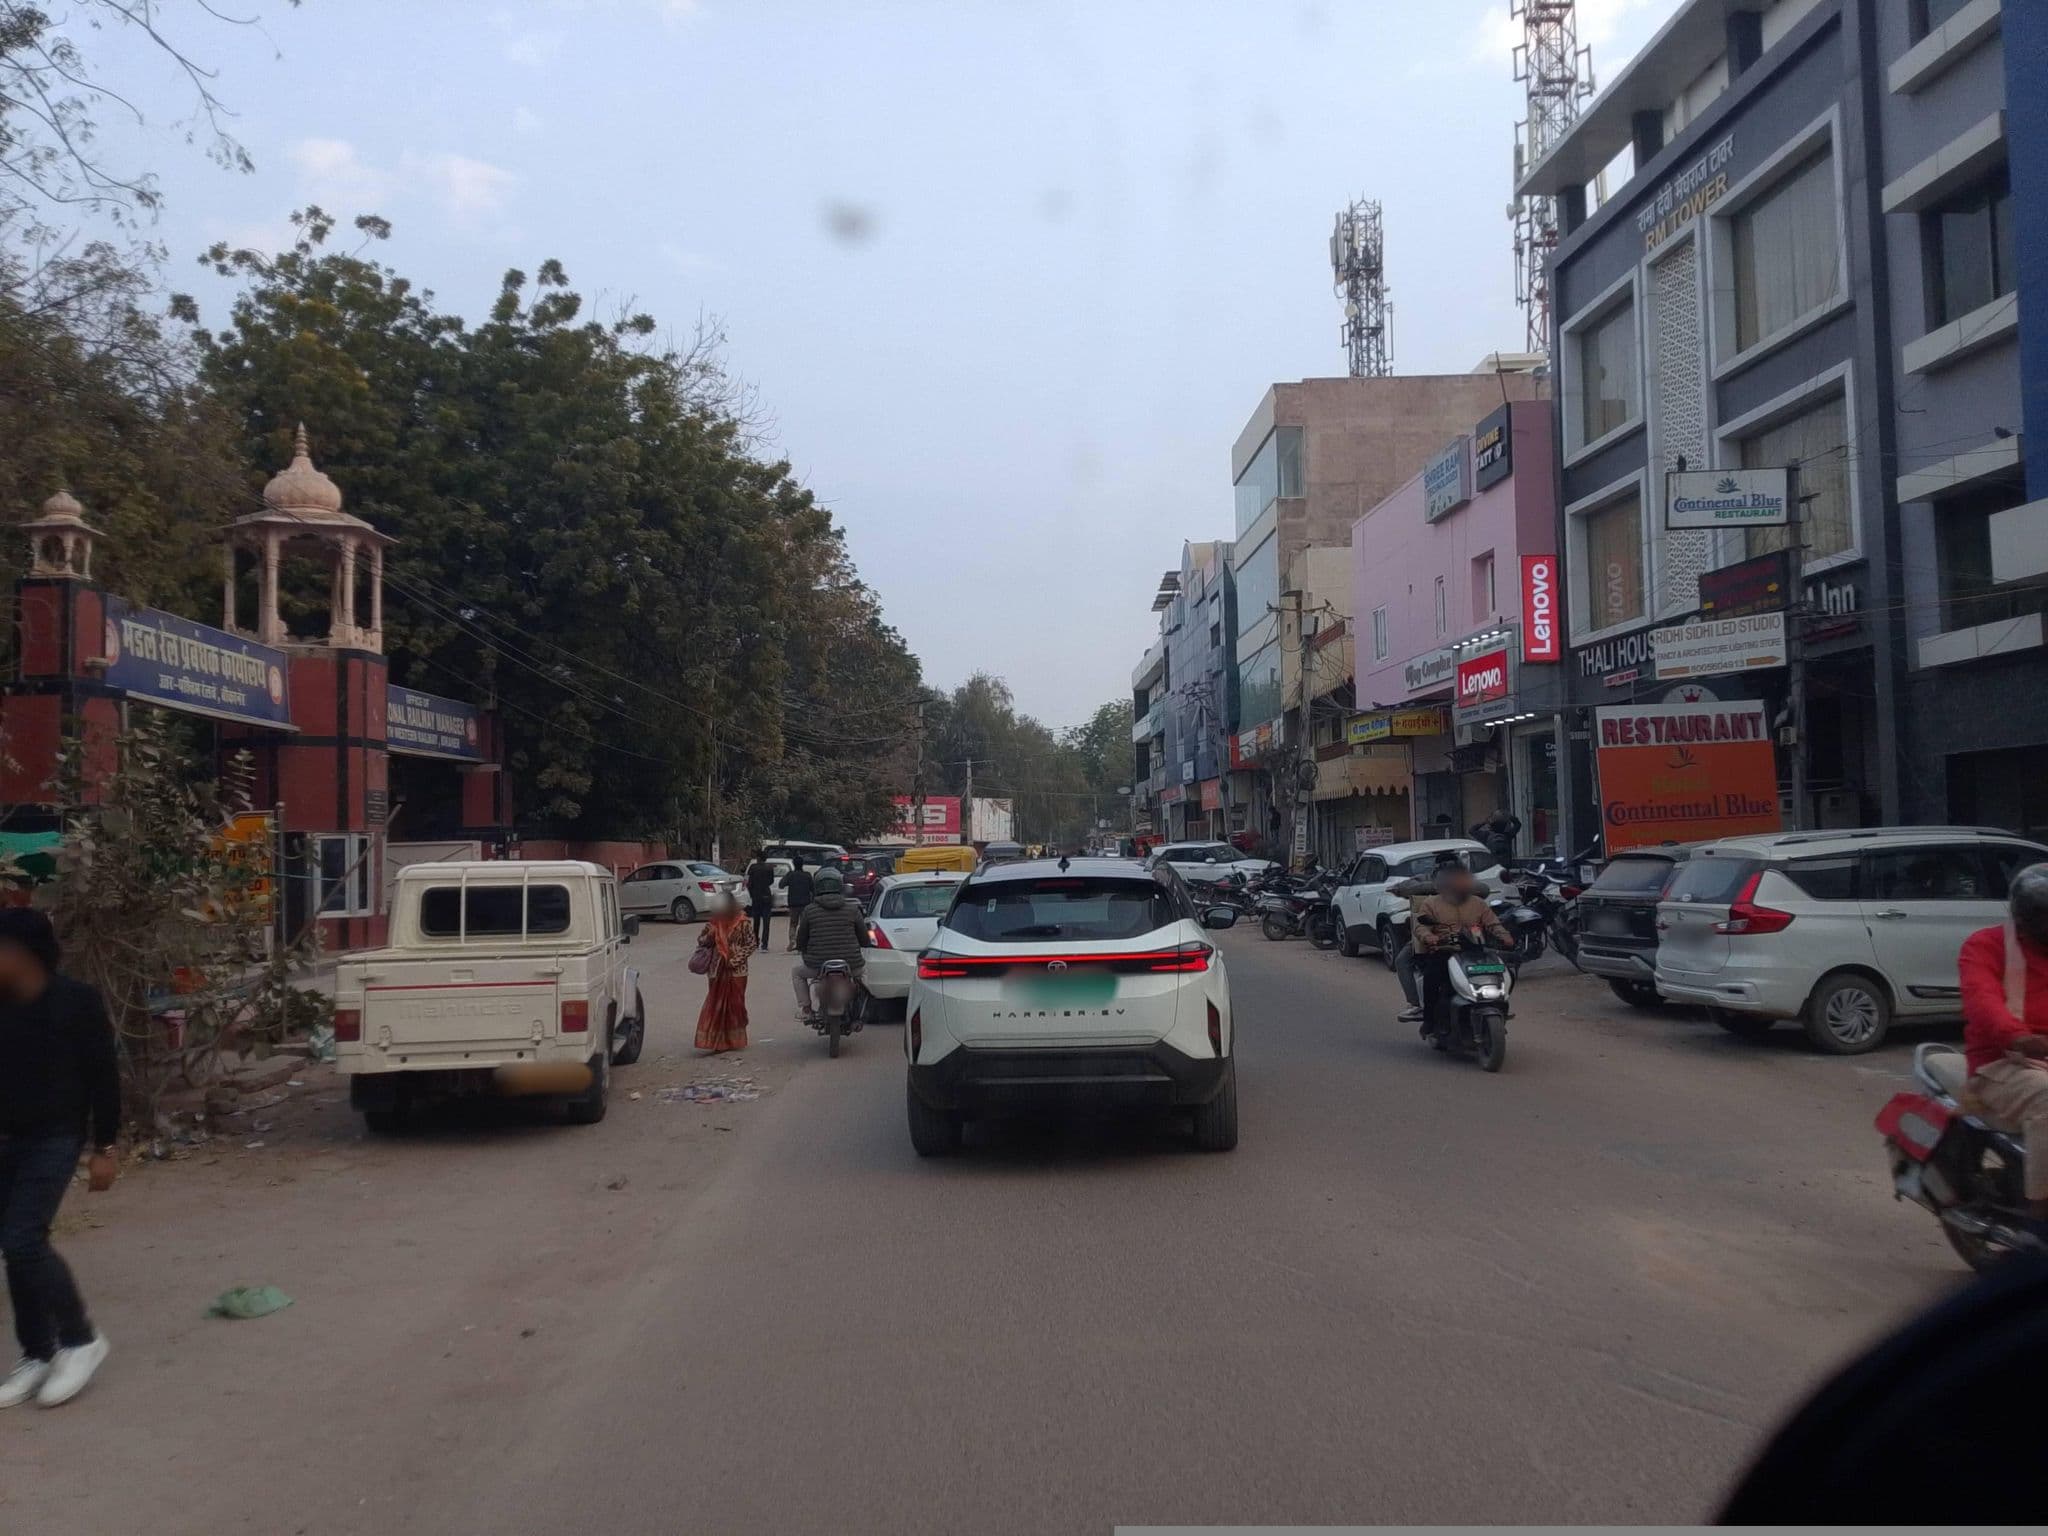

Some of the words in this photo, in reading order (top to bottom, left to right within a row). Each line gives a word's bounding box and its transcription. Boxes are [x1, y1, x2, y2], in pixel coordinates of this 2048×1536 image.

[1657, 182, 1673, 217] देवी
[1708, 132, 1735, 172] टावर
[1645, 219, 1667, 253] RM
[1669, 172, 1728, 230] TOWER
[1674, 493, 1747, 514] Continental
[1751, 493, 1784, 507] Blue
[1715, 508, 1781, 519] RESTAURANT
[1530, 562, 1551, 654] Lenovo
[1821, 582, 1856, 615] Inn
[1656, 629, 1684, 646] RIDHI
[1686, 624, 1714, 642] SIDHI
[1715, 620, 1737, 637] LED
[1740, 615, 1780, 633] STUDIO
[220, 644, 267, 689] कार्यालय
[1578, 641, 1615, 678] THALI
[1462, 667, 1503, 696] Lenovo
[436, 712, 466, 737] MANAGER
[1601, 711, 1762, 746] RESTAURANT
[1605, 793, 1721, 827] Continental
[1725, 792, 1774, 817] Blue
